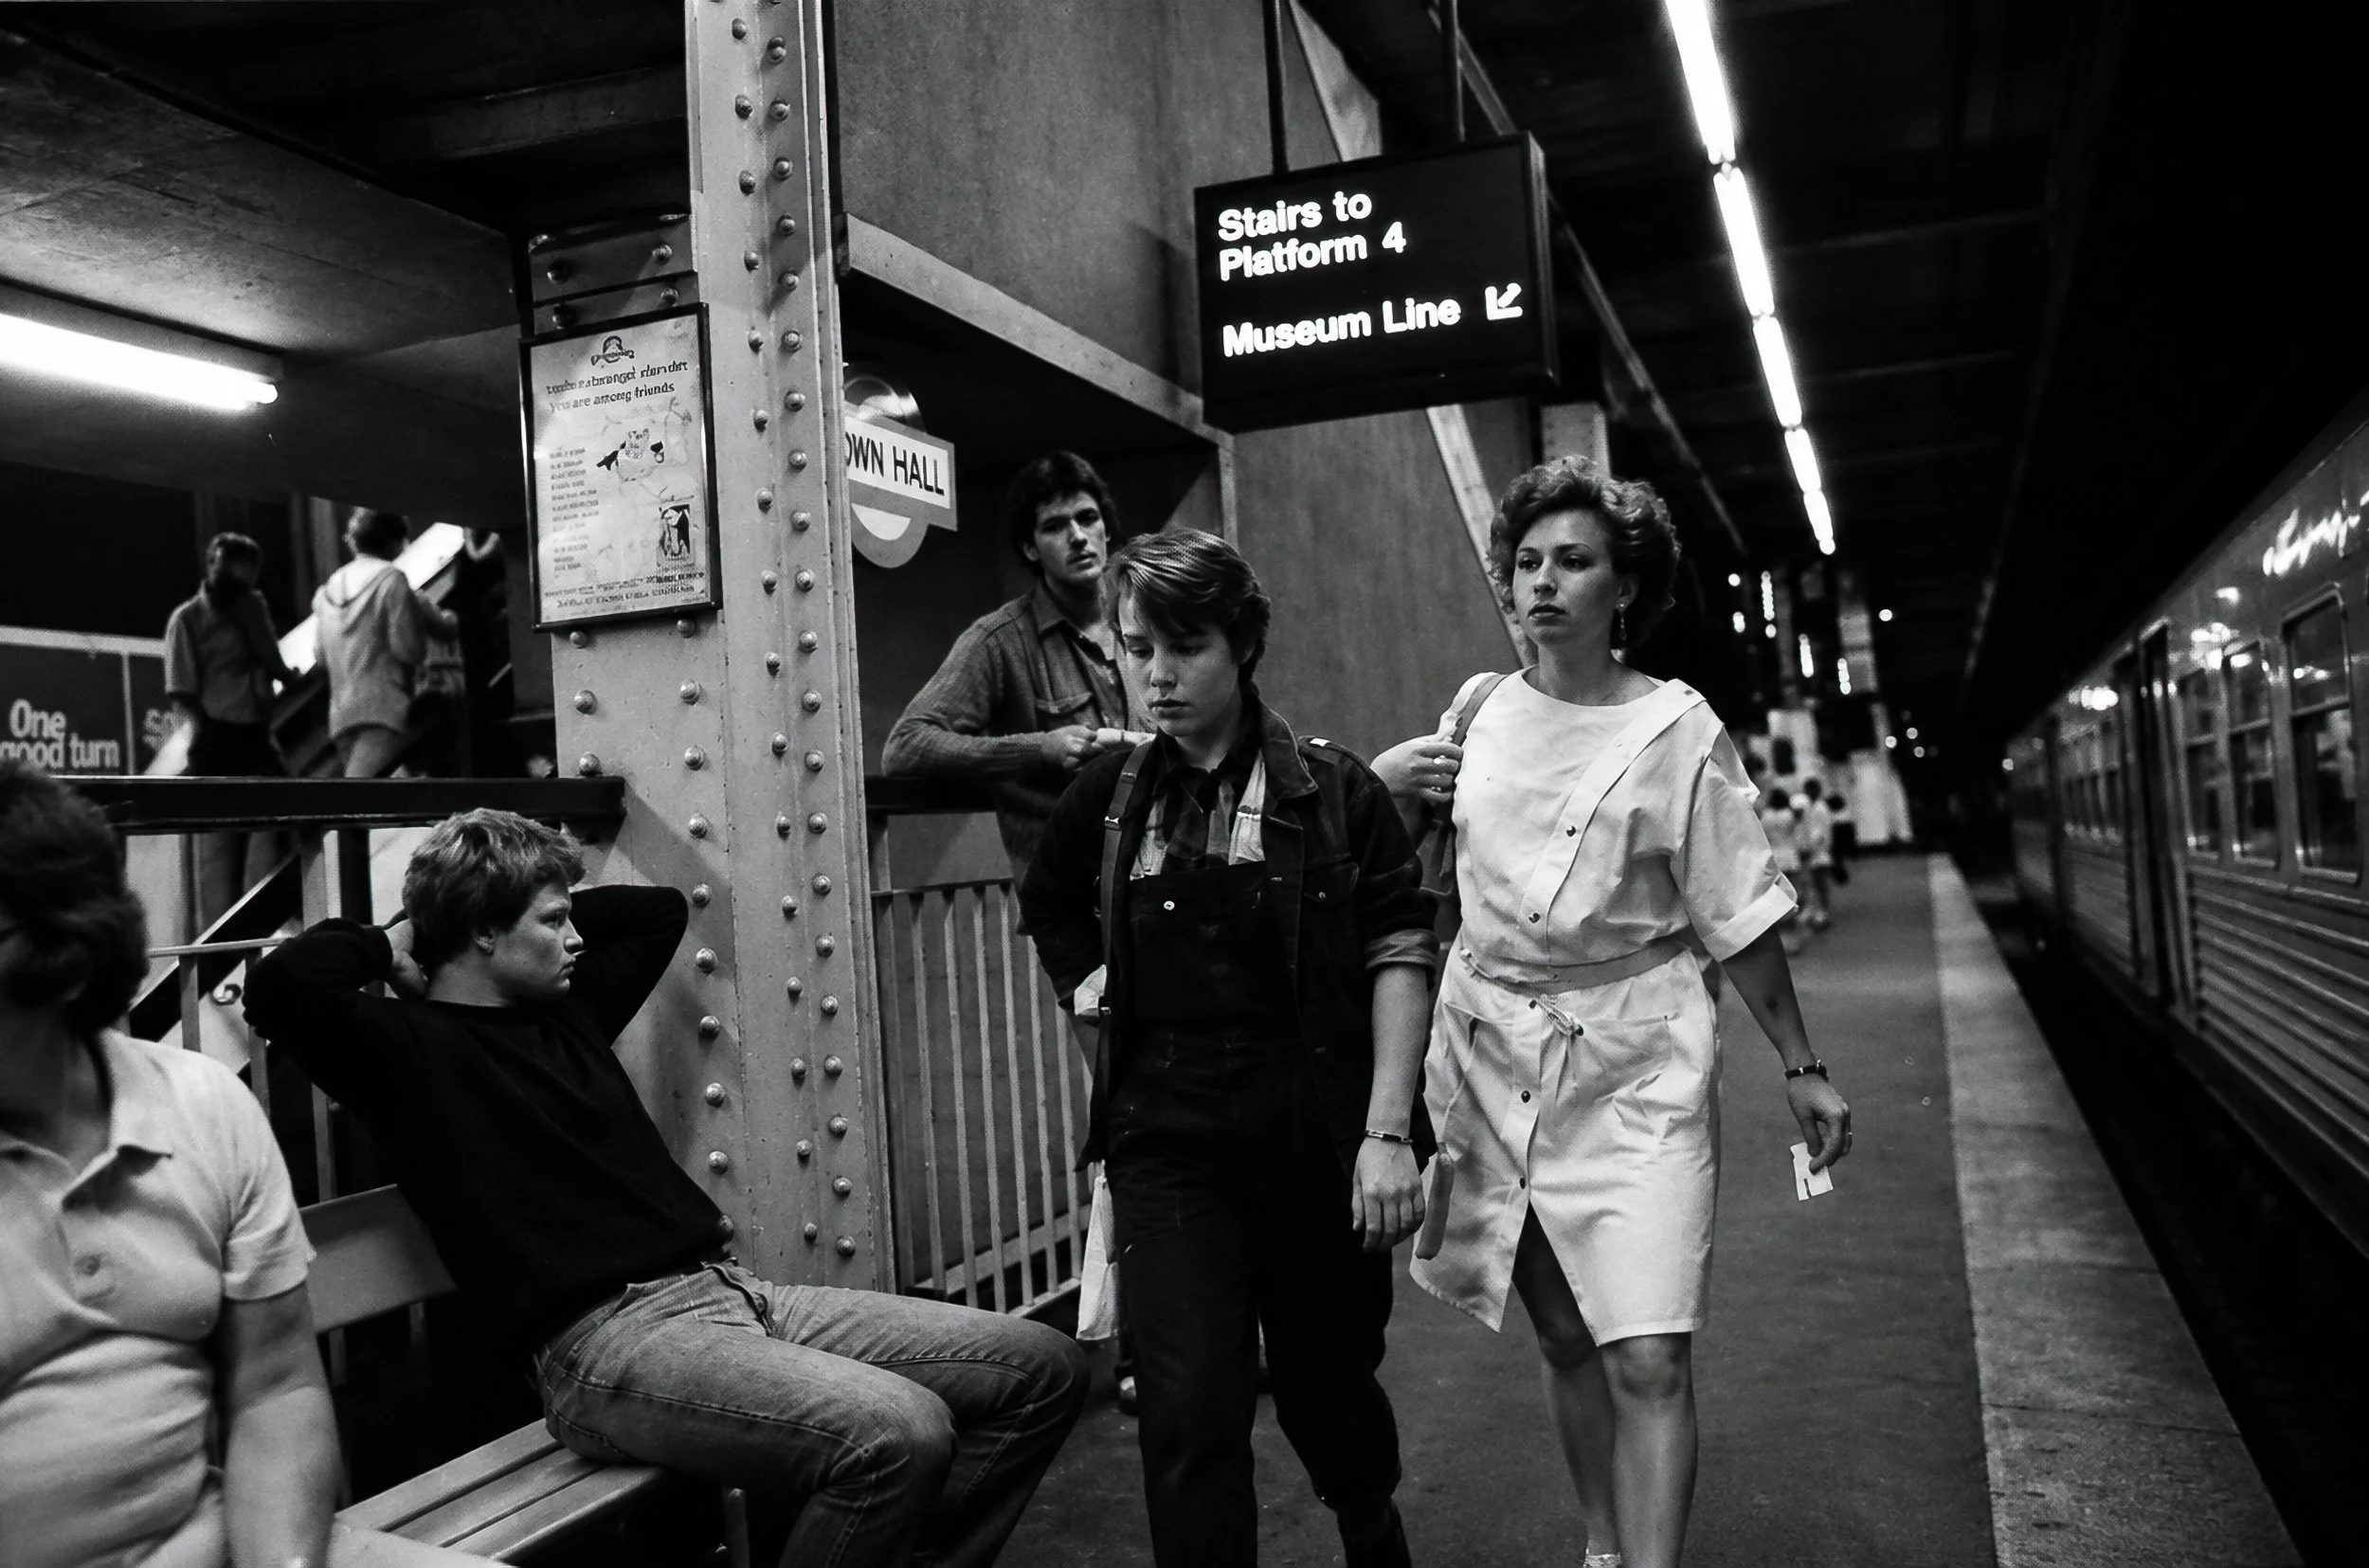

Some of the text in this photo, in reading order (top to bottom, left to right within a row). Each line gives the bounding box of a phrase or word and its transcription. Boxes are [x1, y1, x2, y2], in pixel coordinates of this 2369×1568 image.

[1219, 190, 1372, 242] Stairs to
[1219, 221, 1407, 281] Platform 4
[1222, 297, 1462, 357] Museum Line
[893, 445, 945, 496] HALL
[9, 698, 66, 739] One
[69, 731, 119, 768] turn
